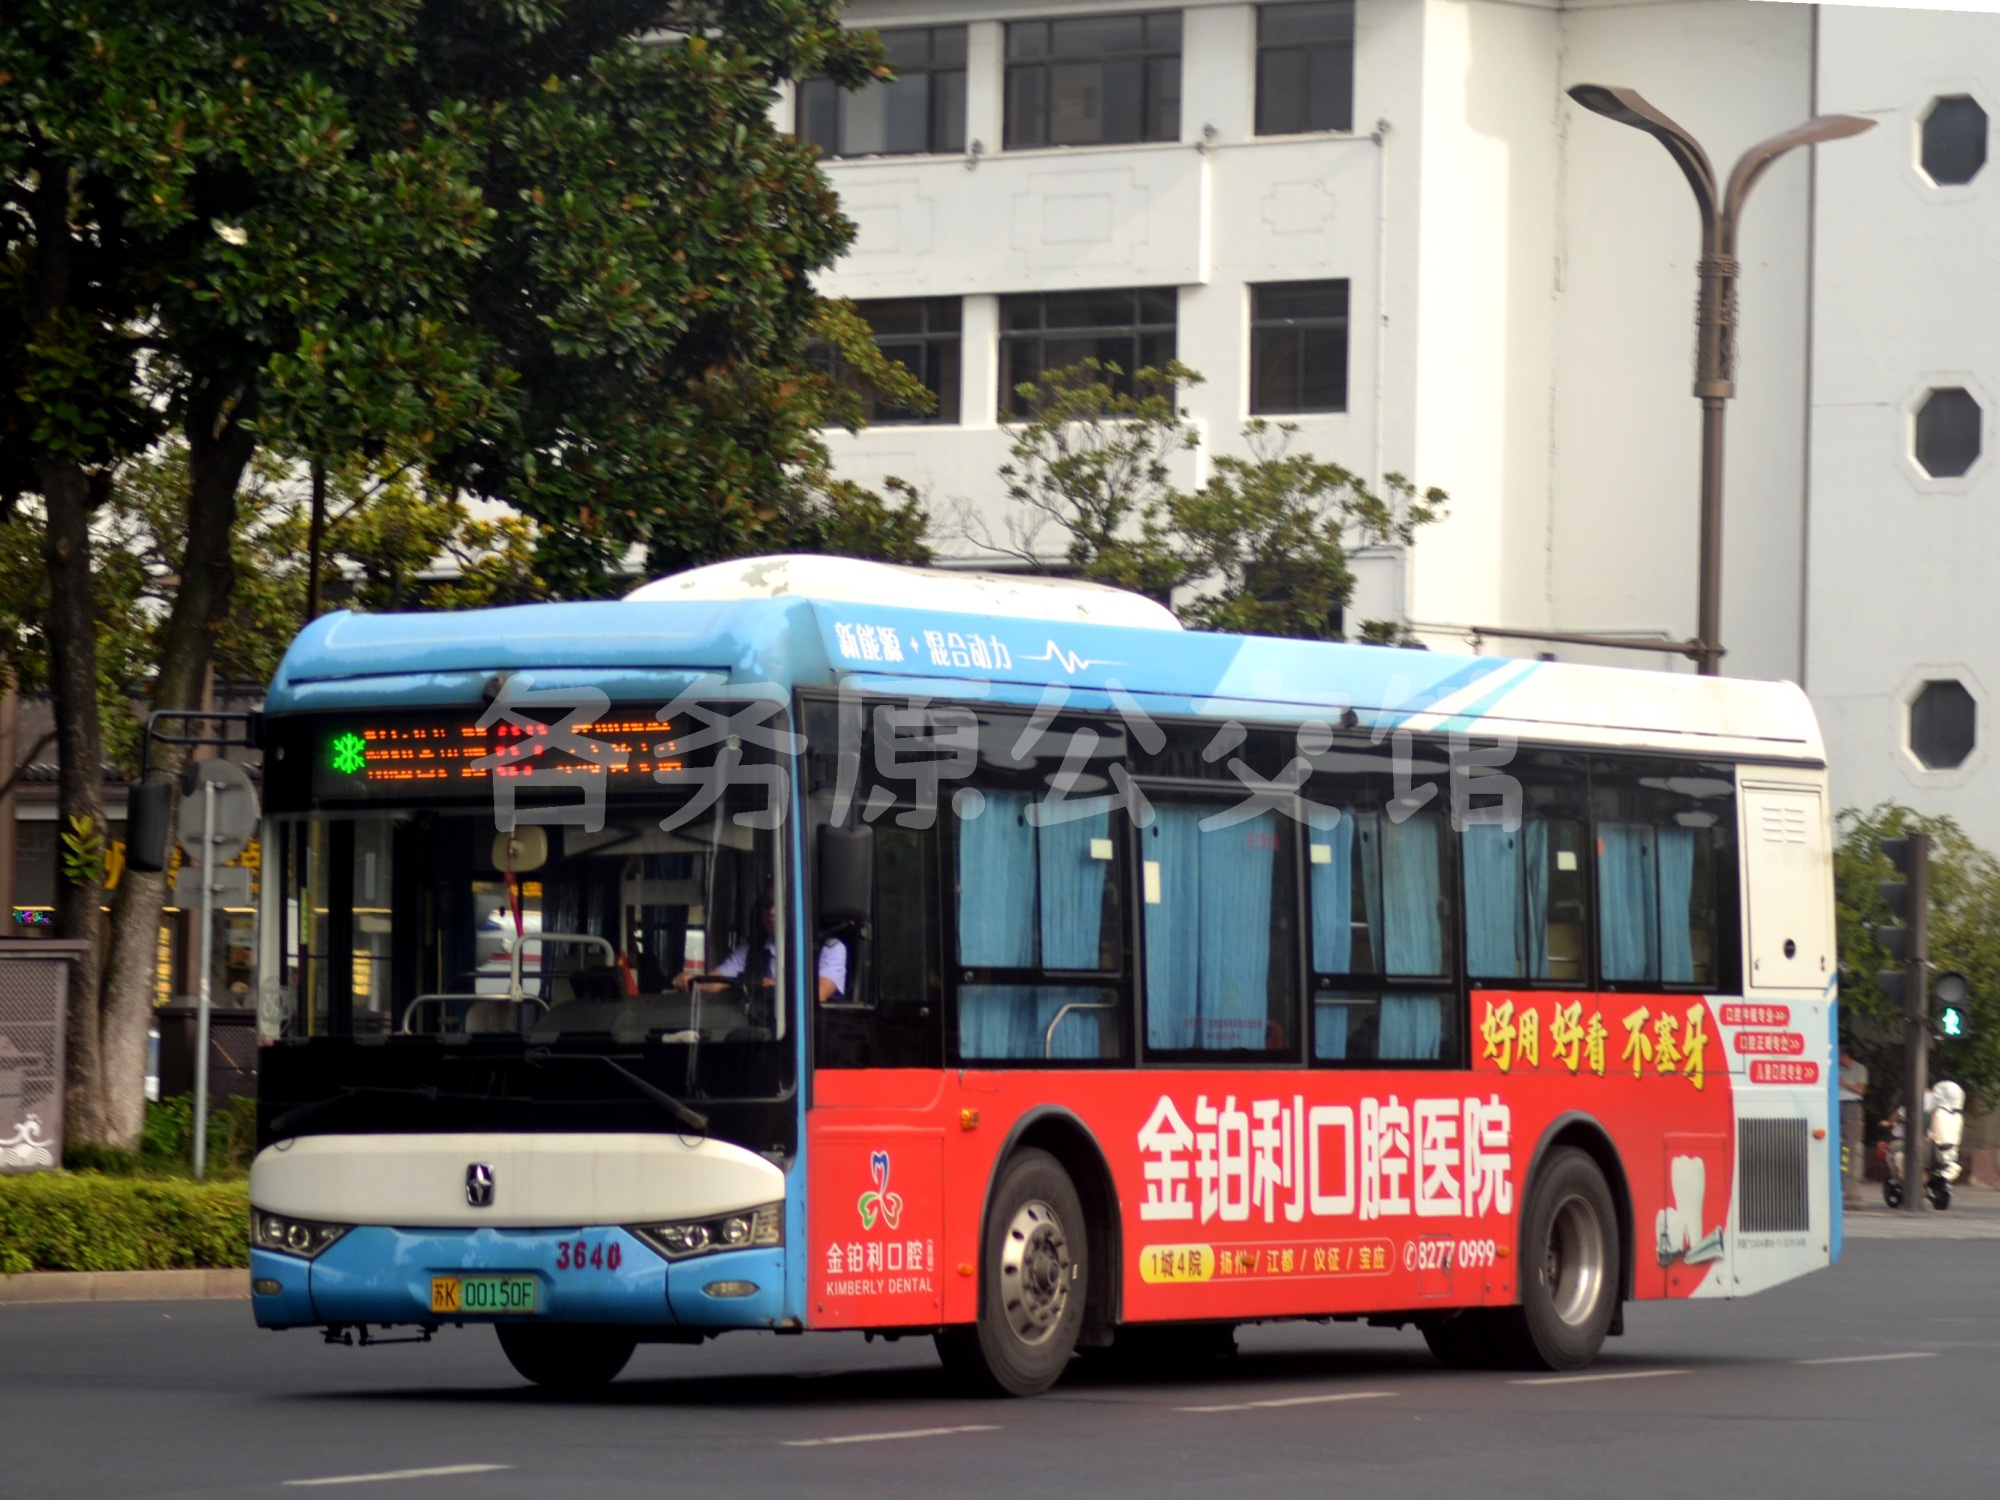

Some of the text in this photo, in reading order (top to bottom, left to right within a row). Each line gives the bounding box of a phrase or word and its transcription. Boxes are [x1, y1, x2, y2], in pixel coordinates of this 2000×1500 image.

[835, 621, 1012, 671] 新能源 混合动力
[1480, 999, 1708, 1090] 好用 好看 不塞牙
[1137, 1094, 1513, 1225] 金铂利口腔医院
[556, 1241, 622, 1271] 3640
[826, 1240, 923, 1274] 金铂利口腔
[1152, 1249, 1202, 1278] 1城4院
[1267, 1248, 1294, 1273] 江都
[1313, 1247, 1340, 1272] 仪征
[1359, 1246, 1385, 1270] 宝应
[1418, 1239, 1495, 1270] 8277 0999
[465, 1282, 533, 1306] 00150F
[826, 1277, 933, 1296] KIMBERLY DENTAL
